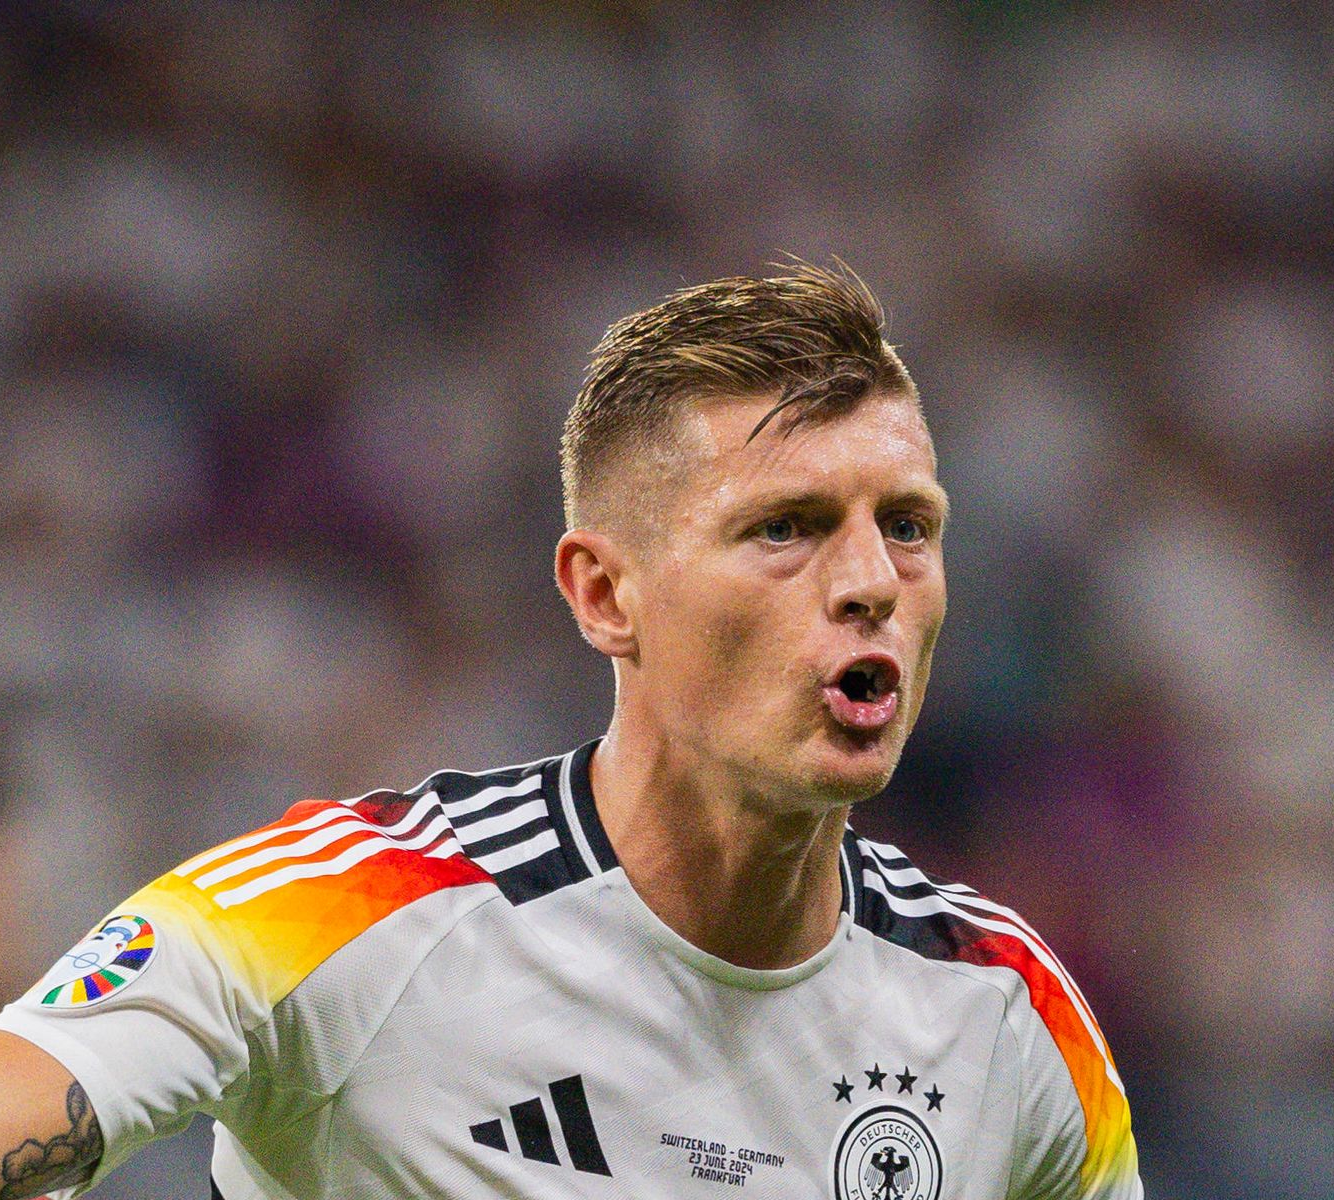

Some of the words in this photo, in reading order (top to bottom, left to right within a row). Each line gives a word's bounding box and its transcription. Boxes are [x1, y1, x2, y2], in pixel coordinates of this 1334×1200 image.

[660, 1133, 727, 1156] SWITZERLAND
[738, 1148, 785, 1168] GERMANY
[859, 1123, 922, 1152] DEUTSCHER
[688, 1152, 701, 1165] 23
[703, 1155, 726, 1170] JUNE
[729, 1159, 753, 1176] 2024
[691, 1166, 747, 1188] FRANKFURT
